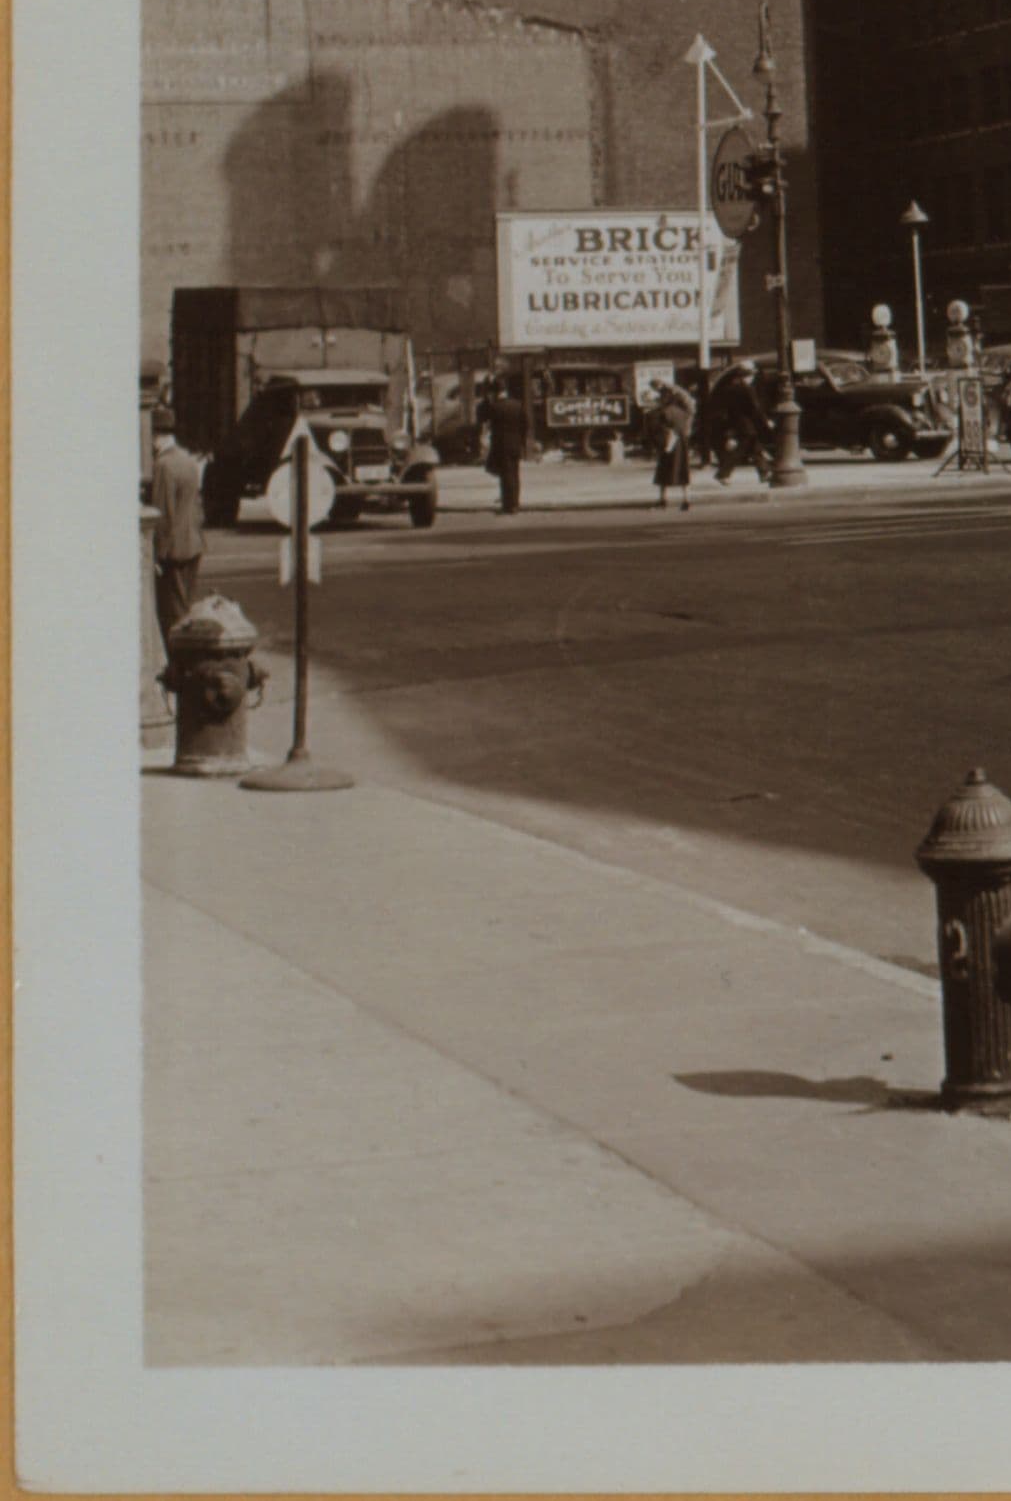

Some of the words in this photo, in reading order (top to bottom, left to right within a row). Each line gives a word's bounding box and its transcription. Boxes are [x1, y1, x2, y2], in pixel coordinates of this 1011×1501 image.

[530, 255, 612, 268] SERVICE
[544, 268, 571, 286] To
[580, 269, 647, 286] Serve
[655, 265, 694, 285] You
